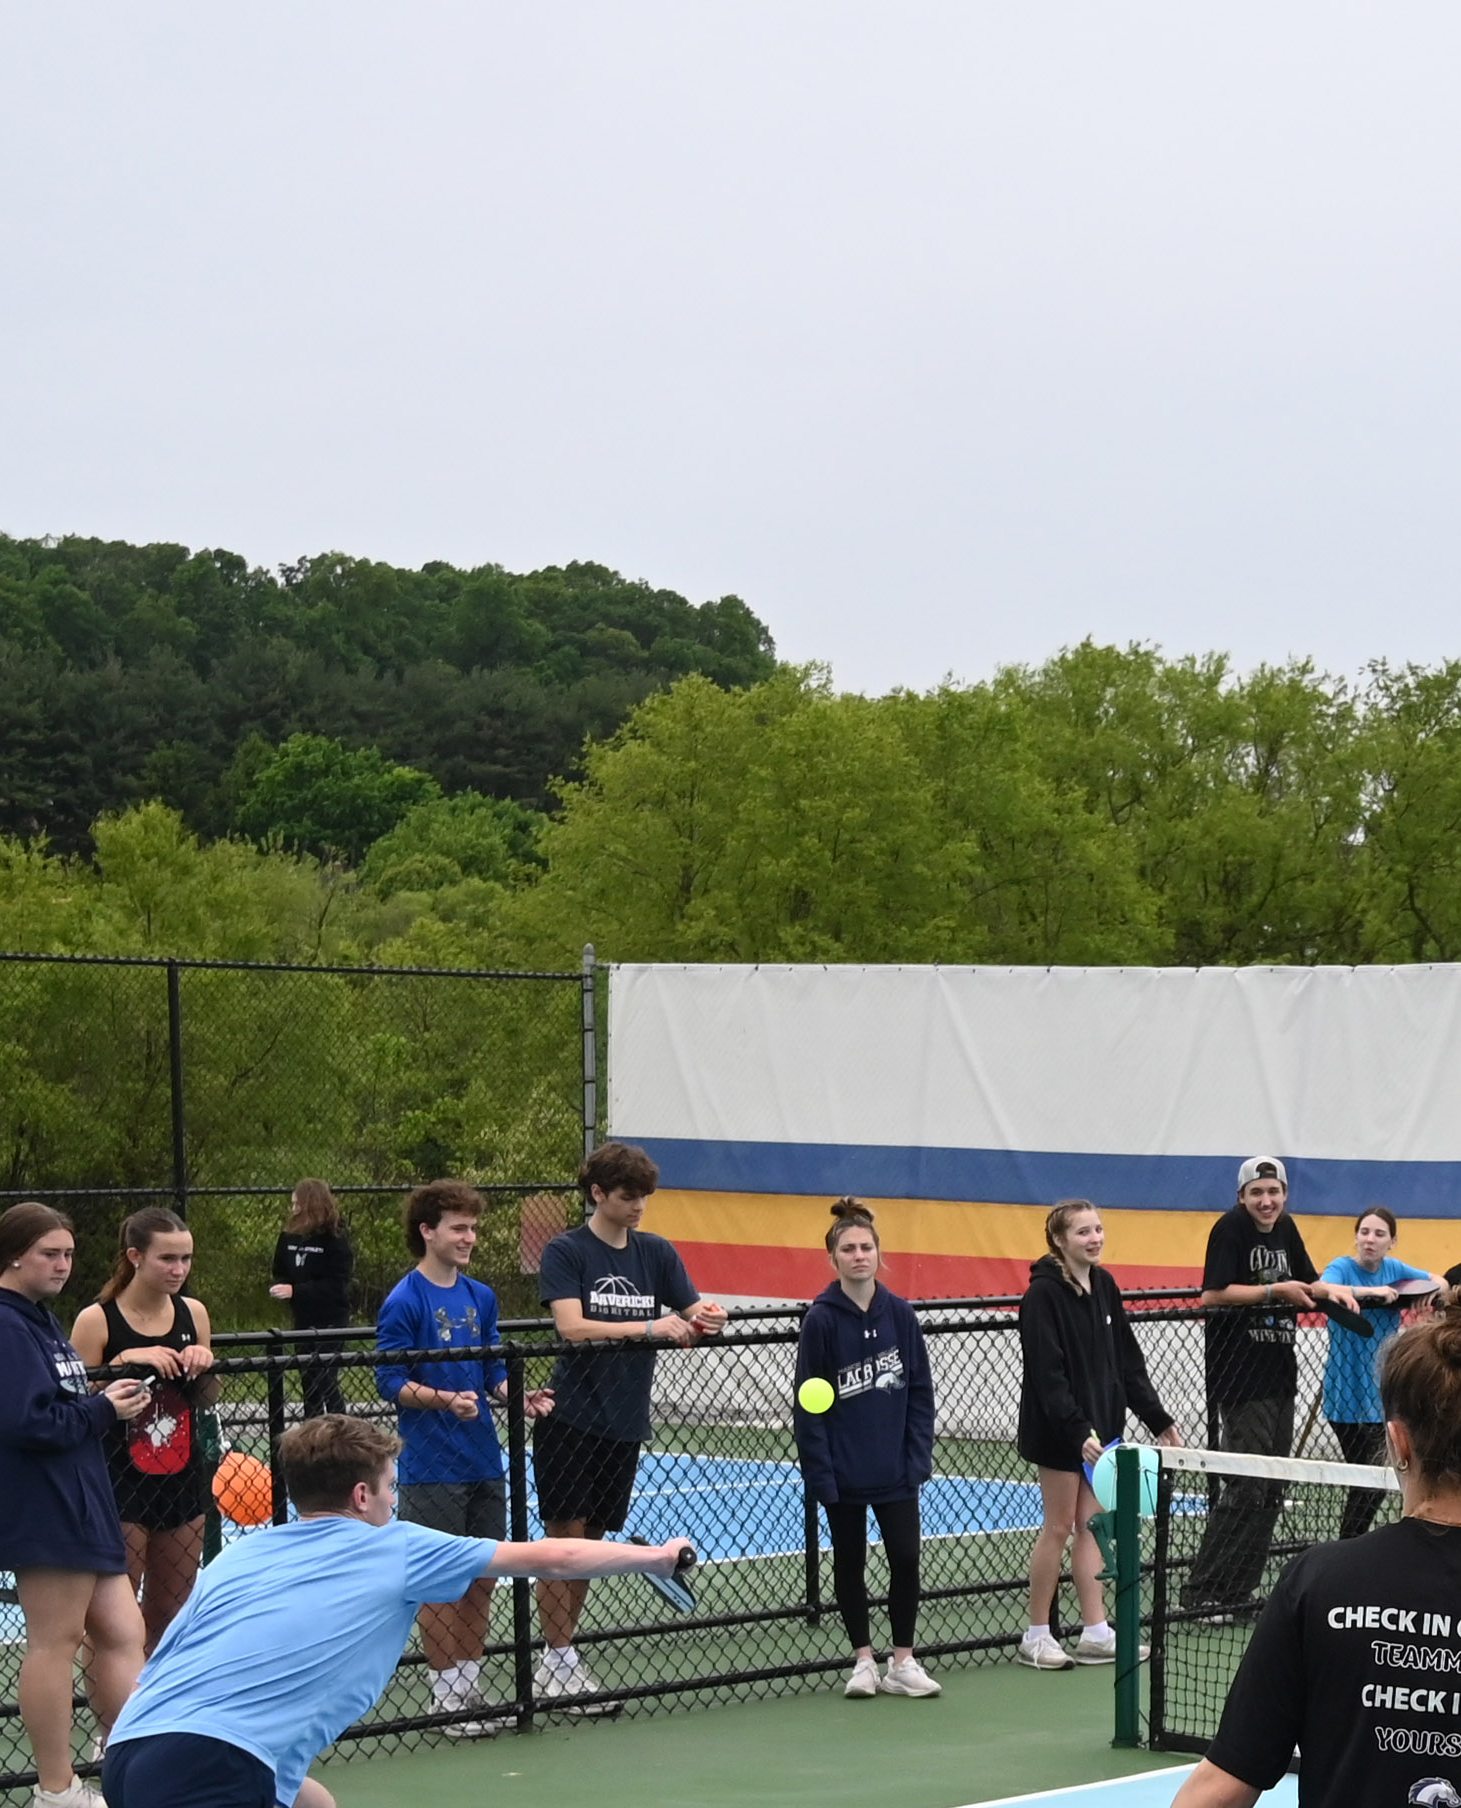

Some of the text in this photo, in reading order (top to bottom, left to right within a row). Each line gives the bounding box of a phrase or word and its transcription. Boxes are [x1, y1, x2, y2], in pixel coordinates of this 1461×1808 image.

[1327, 1606, 1418, 1633] CHECK
[1422, 1613, 1451, 1638] IN
[1361, 1684, 1447, 1714] CHECK
